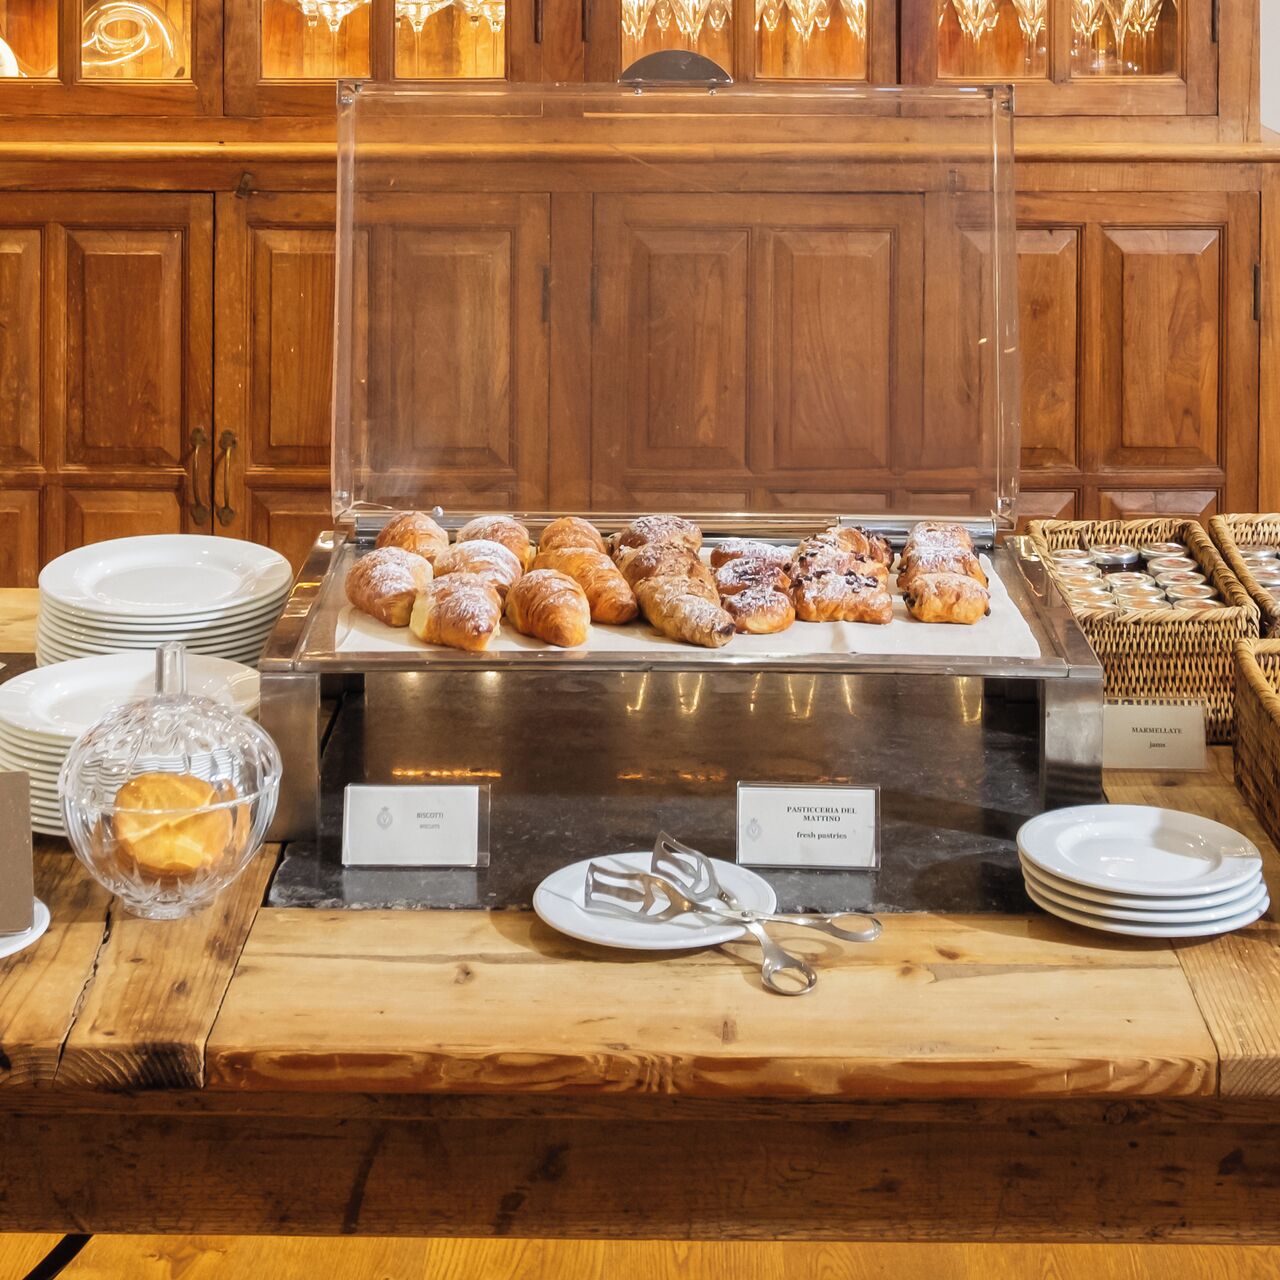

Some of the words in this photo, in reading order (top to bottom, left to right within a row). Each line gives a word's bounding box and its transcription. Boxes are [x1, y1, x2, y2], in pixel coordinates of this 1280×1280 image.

[787, 806, 838, 814] PASTICCERIA
[796, 831, 816, 839] fresh
[817, 832, 847, 840] pastries
